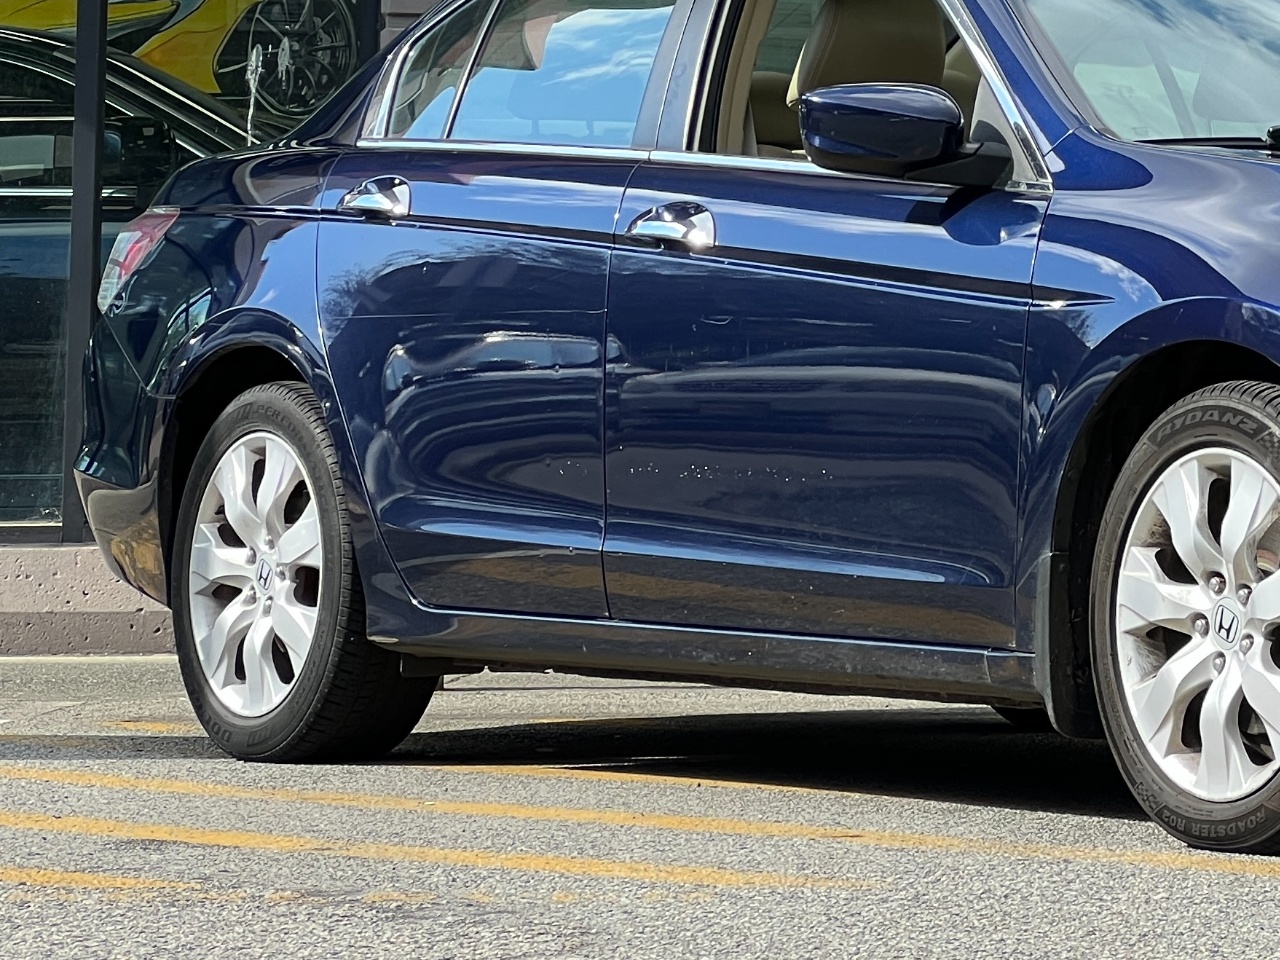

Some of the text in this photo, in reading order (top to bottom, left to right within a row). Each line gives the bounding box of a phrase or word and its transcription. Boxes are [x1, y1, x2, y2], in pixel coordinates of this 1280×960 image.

[1156, 409, 1259, 442] RYDANZ
[1160, 807, 1268, 838] ROADSTER R02
